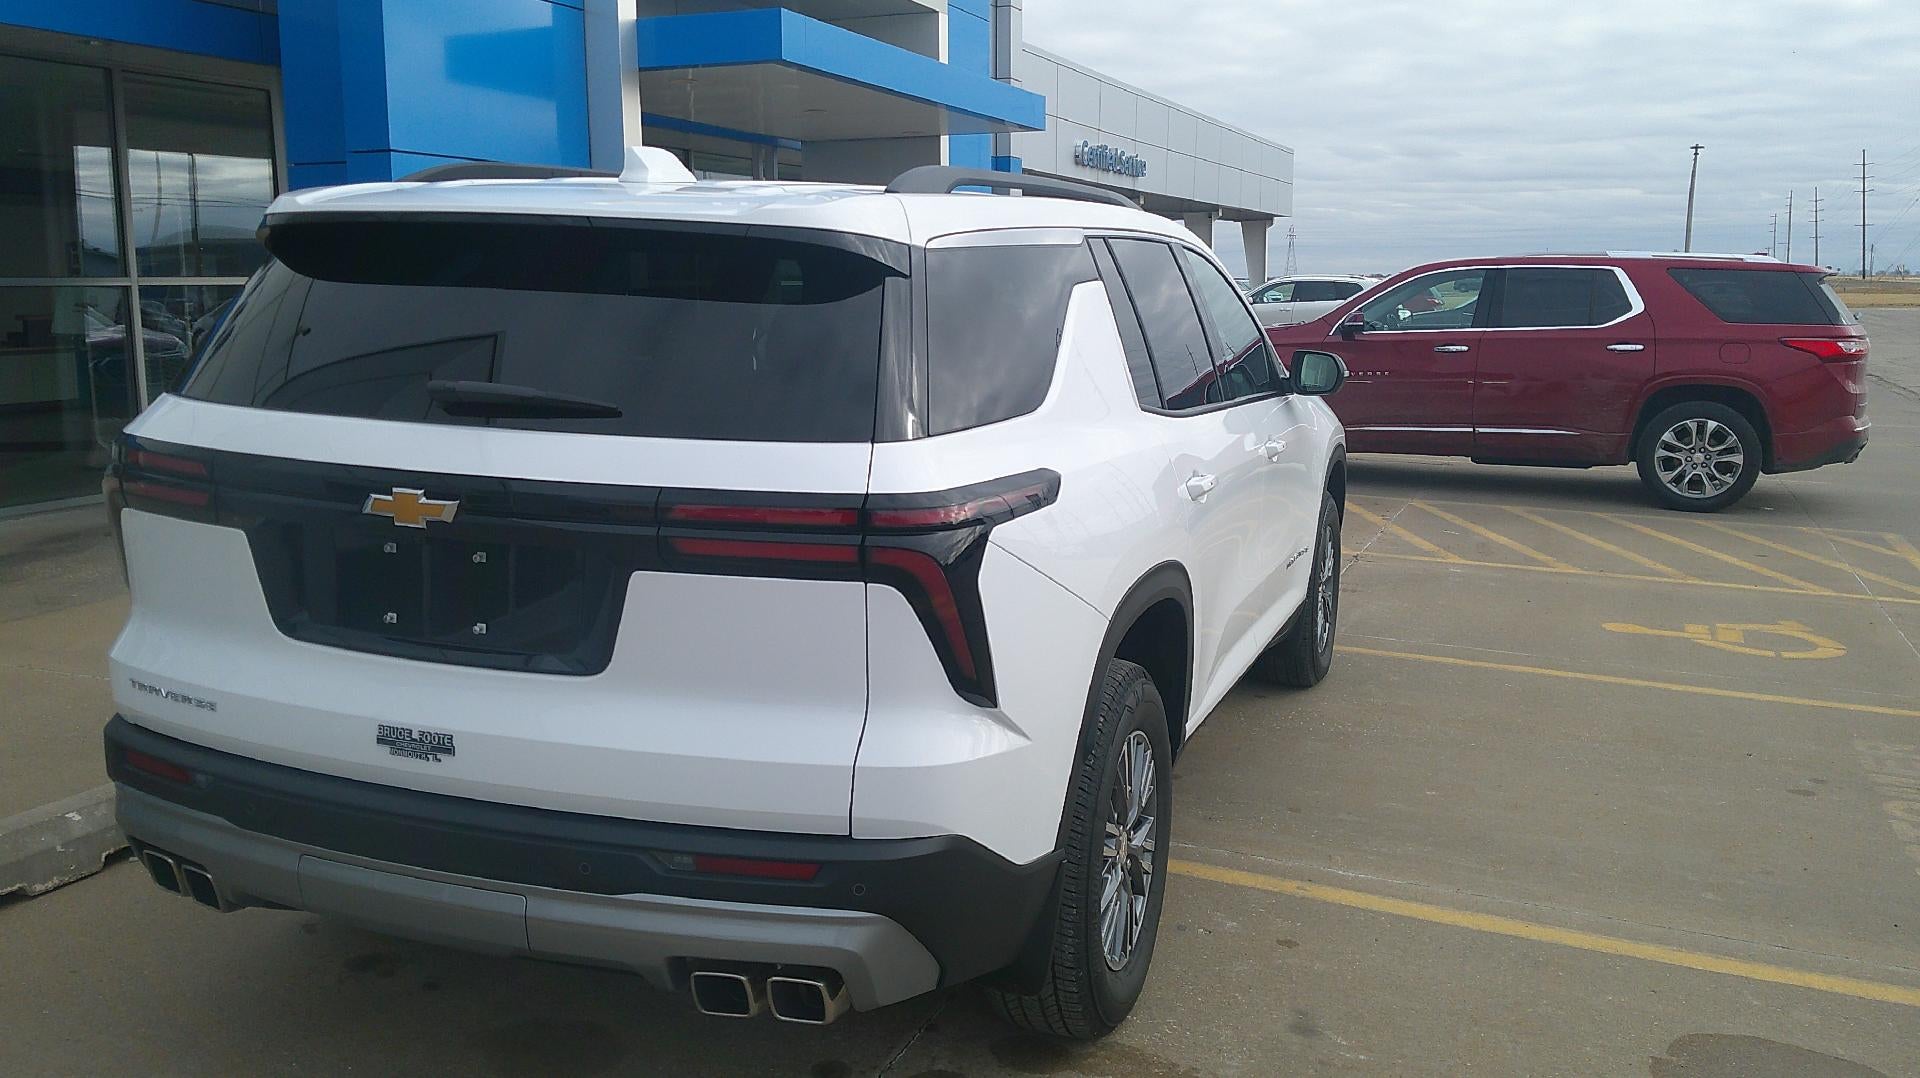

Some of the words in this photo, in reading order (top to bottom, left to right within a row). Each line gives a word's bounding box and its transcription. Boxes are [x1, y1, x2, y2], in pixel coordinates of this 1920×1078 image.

[129, 678, 217, 712] TRAVERSE
[377, 724, 413, 741] BRUCE
[417, 730, 453, 747] FOOTE
